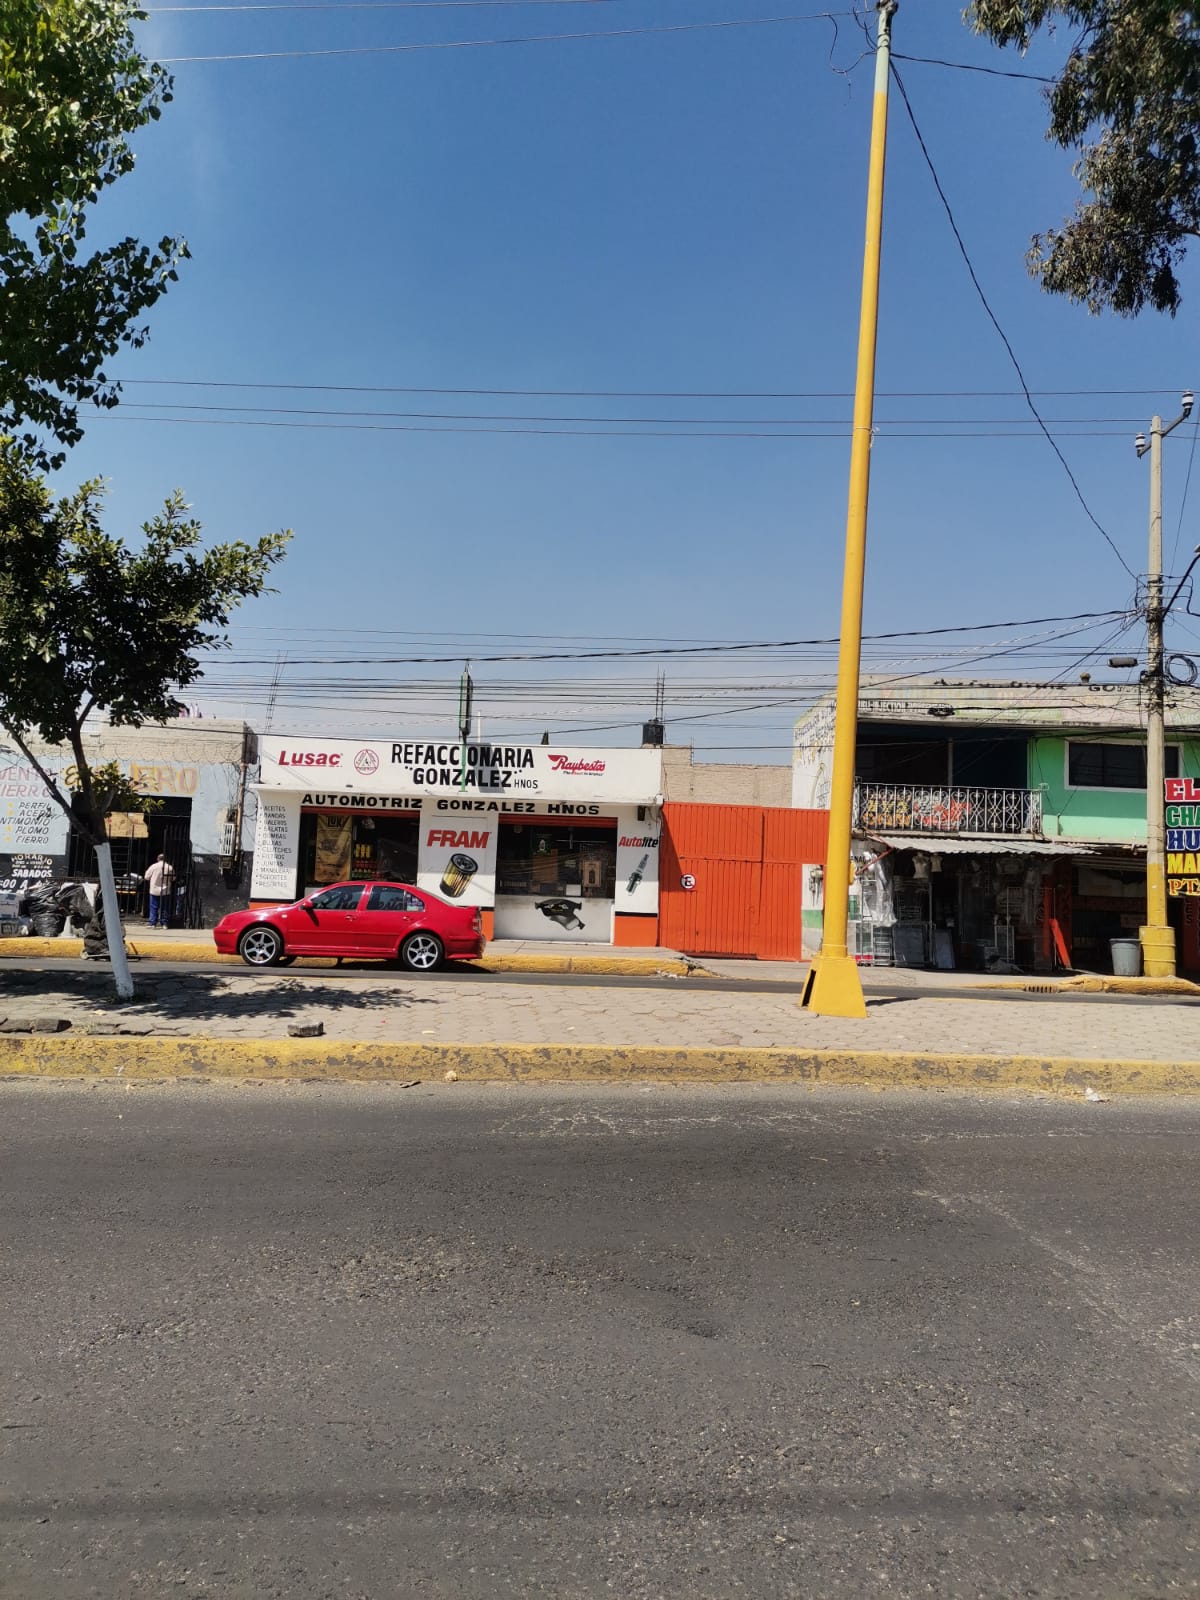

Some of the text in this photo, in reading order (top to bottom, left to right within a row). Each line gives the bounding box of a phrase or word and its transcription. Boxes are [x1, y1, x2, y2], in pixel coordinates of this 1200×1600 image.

[278, 750, 341, 766] Lusac
[391, 744, 535, 769] REFACCONARIA
[547, 754, 606, 775] Raybestos
[514, 780, 539, 789] HNOS
[302, 793, 600, 815] AUTOMOTRIZ GONZALEZ HNOS
[15, 826, 50, 835] PLOMO
[427, 830, 491, 849] FRAM
[619, 836, 659, 848] Autolite
[11, 868, 53, 879] SABADOS
[1167, 853, 1200, 875] MA
[1168, 878, 1200, 897] PT
